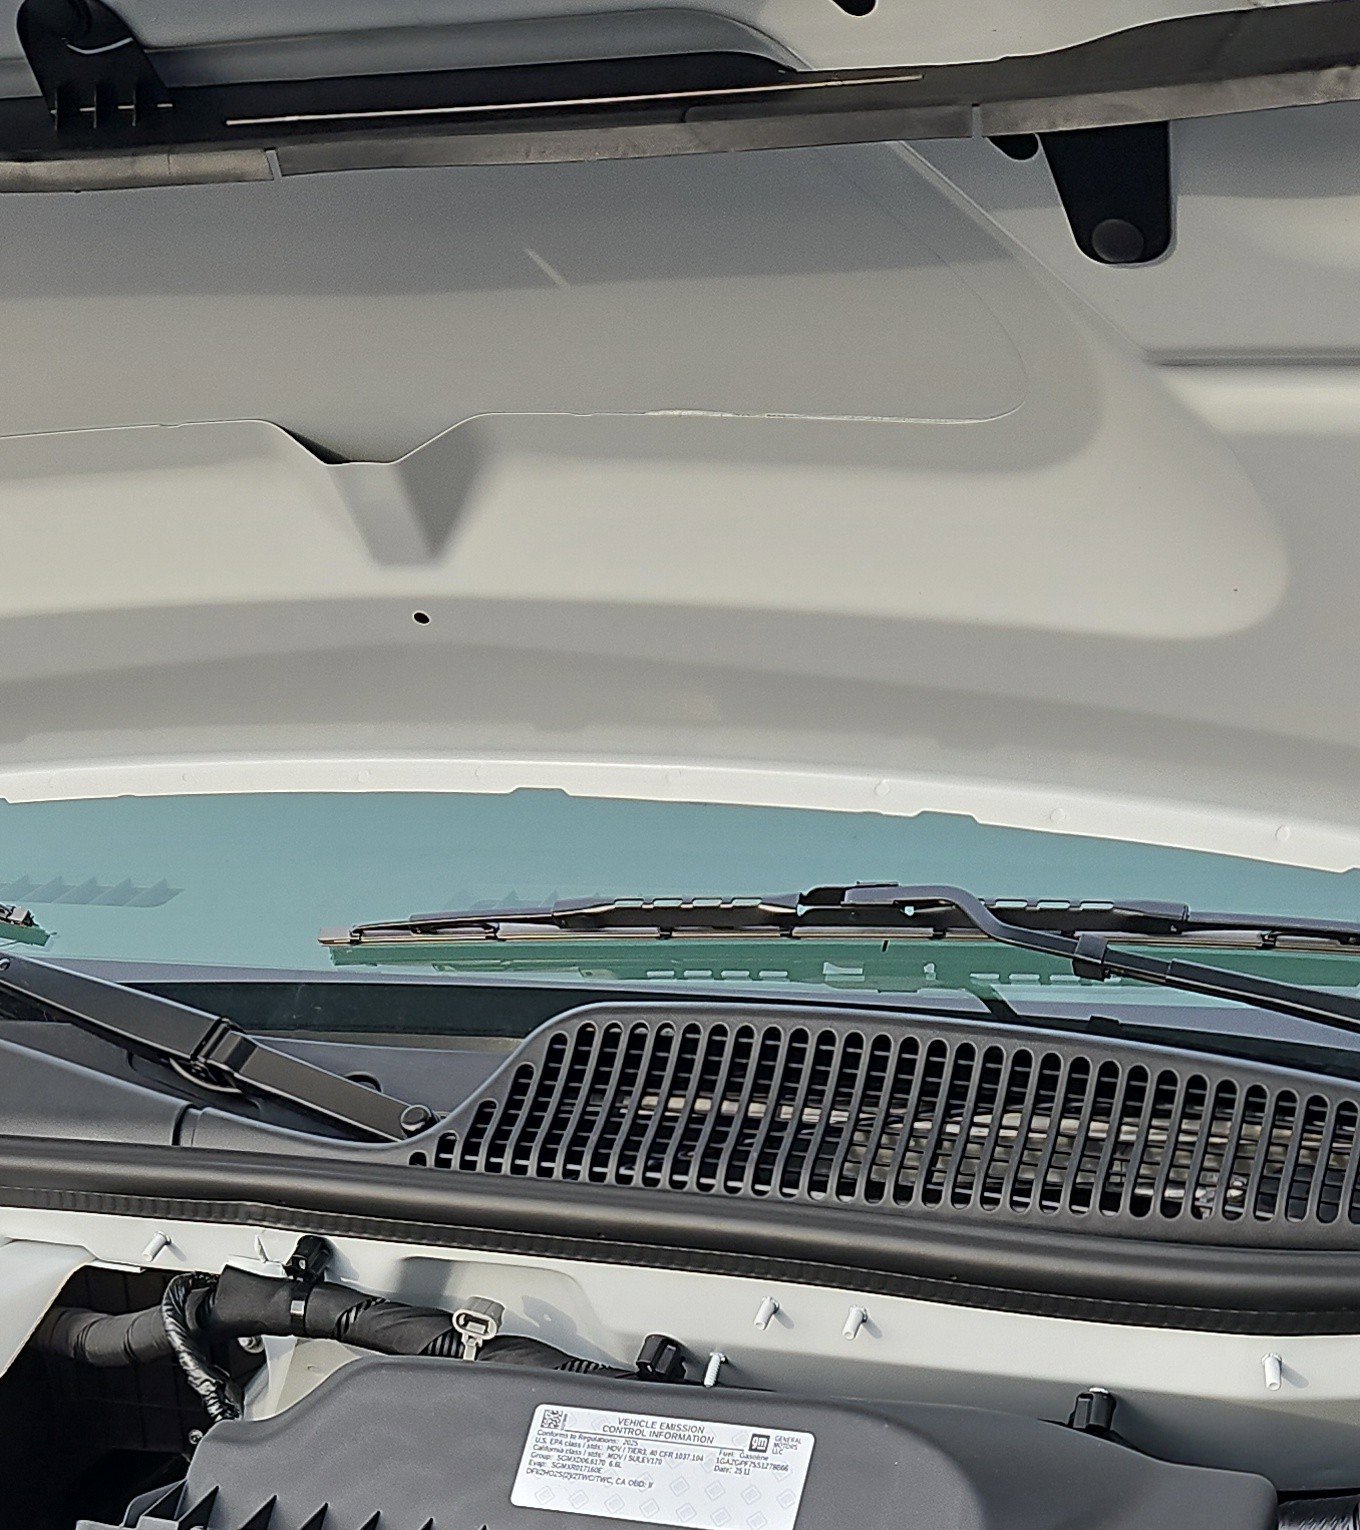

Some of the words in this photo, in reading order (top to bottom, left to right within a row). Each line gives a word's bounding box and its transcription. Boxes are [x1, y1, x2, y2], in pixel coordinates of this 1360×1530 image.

[618, 1417, 657, 1429] VEHICLE
[659, 1422, 705, 1434] EMISSION
[537, 1429, 568, 1438] Conforms
[602, 1425, 646, 1437] CONTROL
[649, 1430, 714, 1444] INFORMATION
[774, 1435, 802, 1445] GENERAL
[533, 1444, 564, 1454] California
[659, 1451, 674, 1459] CFR
[615, 1477, 626, 1485] CA
